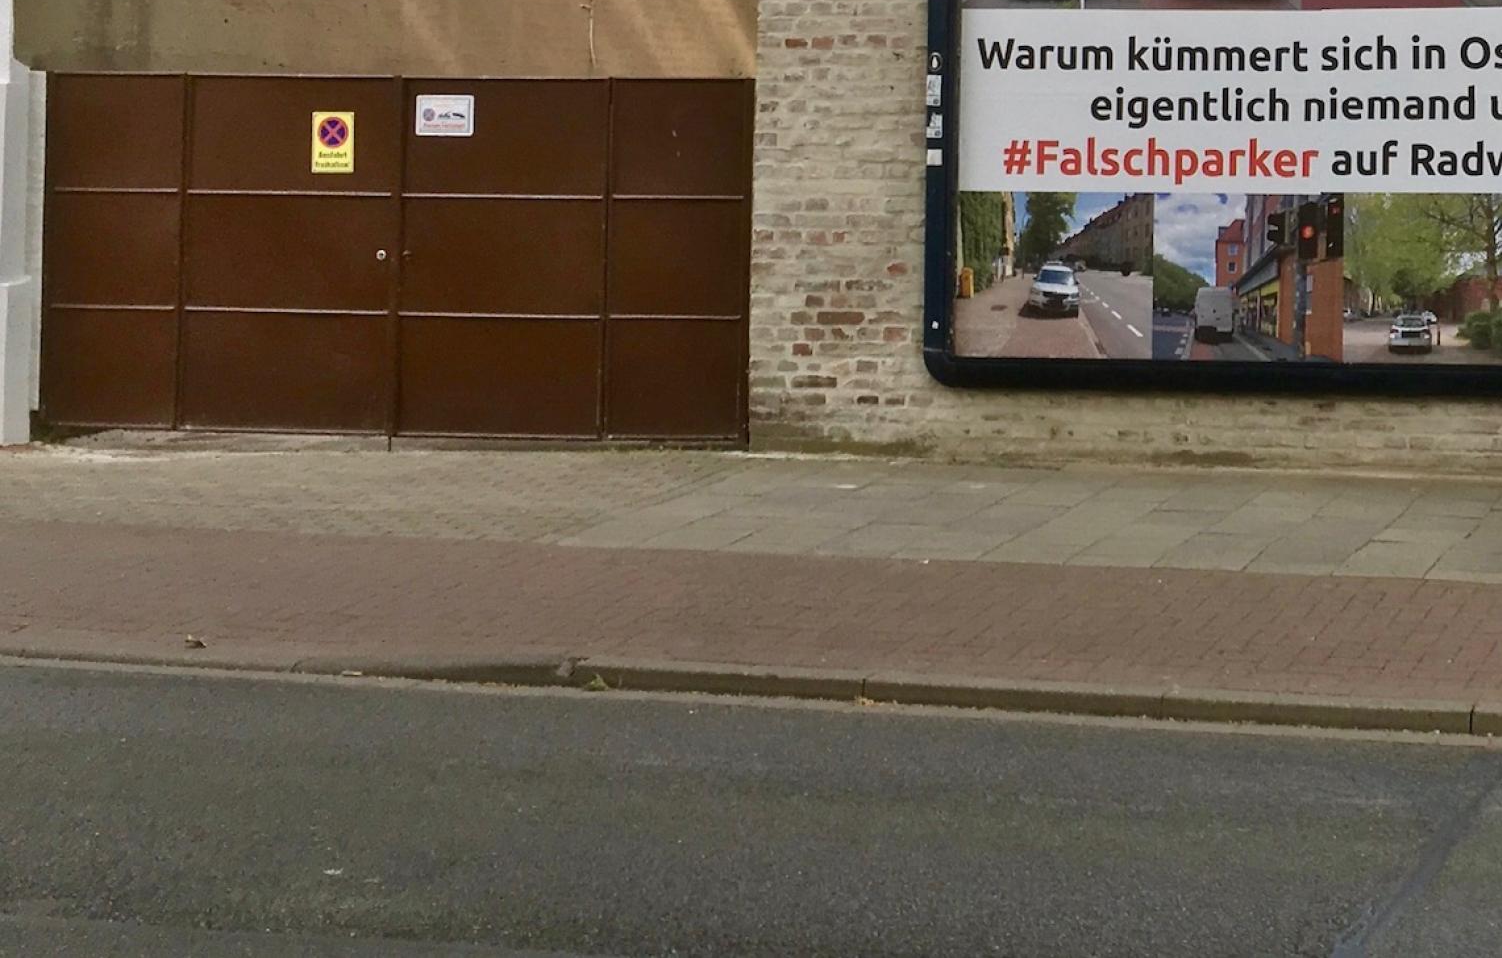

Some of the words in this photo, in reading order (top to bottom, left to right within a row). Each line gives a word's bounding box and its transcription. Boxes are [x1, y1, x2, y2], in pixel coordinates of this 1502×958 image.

[977, 38, 1113, 71] Warum
[1128, 36, 1308, 72] kümmert
[1320, 35, 1397, 71] sich
[1411, 34, 1446, 70] in
[1090, 86, 1290, 129] eigentlich
[1304, 85, 1476, 122] niemand
[1003, 137, 1319, 184] #Falschparker
[1331, 140, 1398, 176] auf
